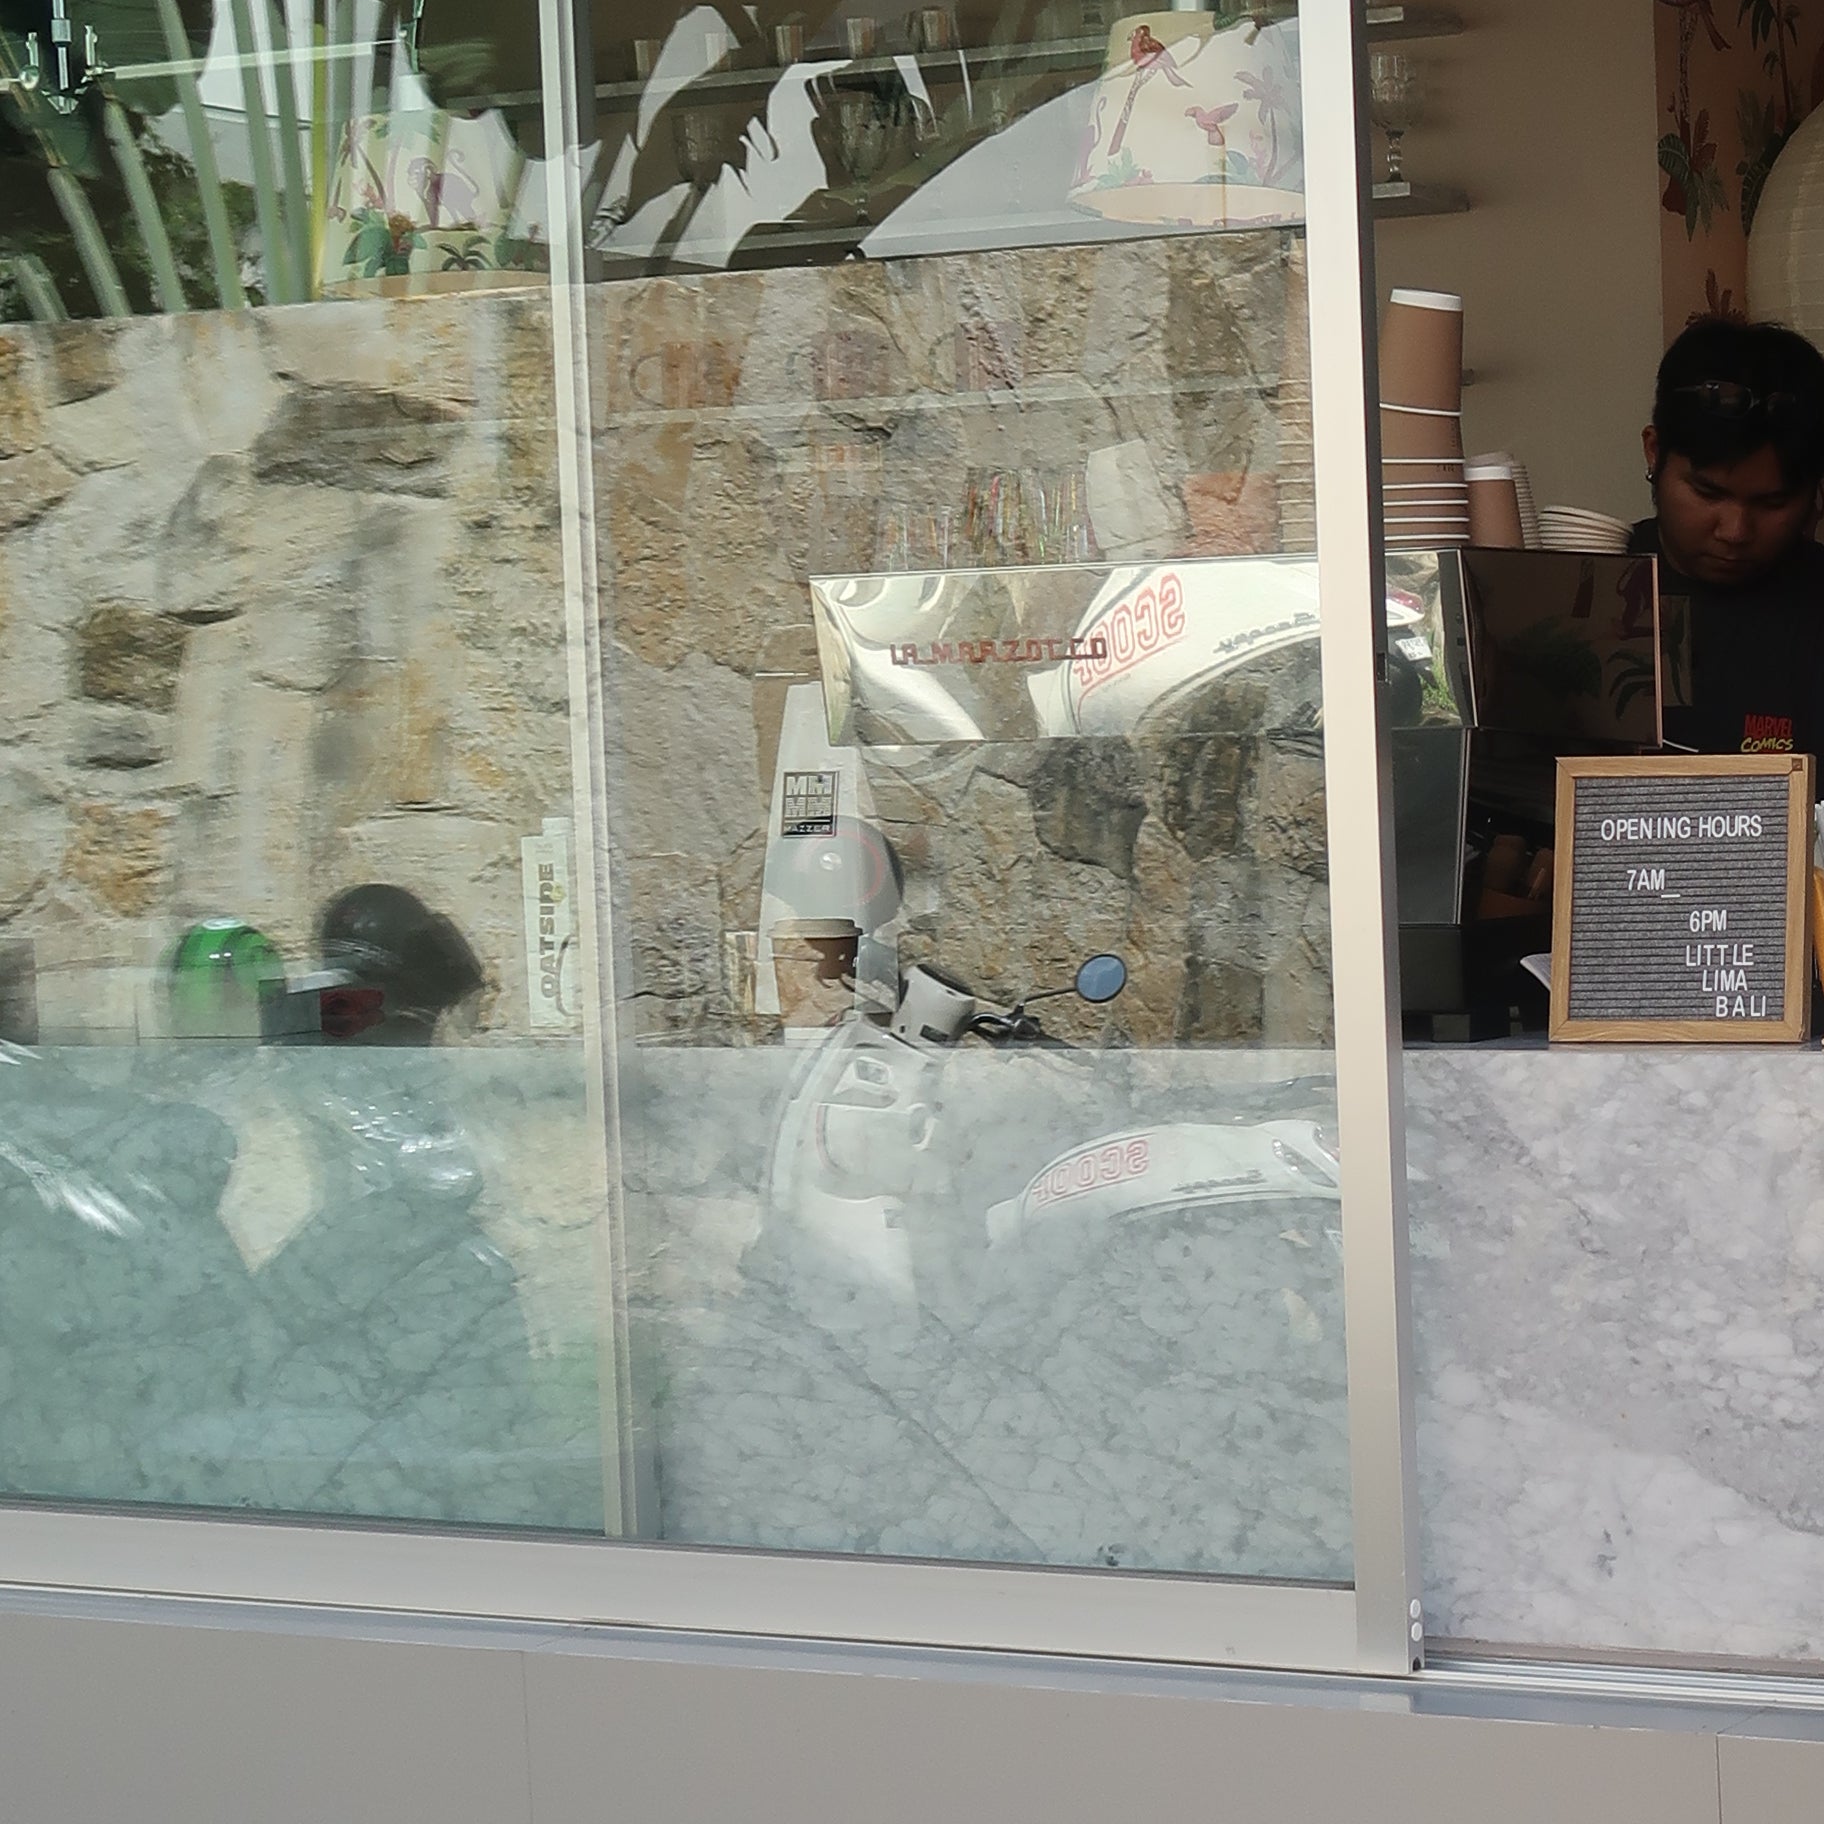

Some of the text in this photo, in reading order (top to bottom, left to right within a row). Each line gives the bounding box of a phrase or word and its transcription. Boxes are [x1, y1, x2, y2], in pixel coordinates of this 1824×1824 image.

[1744, 714, 1793, 738] MARVEL
[1600, 814, 1763, 841] OPENING HOURS
[1626, 868, 1666, 891] 7AM
[538, 862, 559, 999] OATSIDE
[1689, 909, 1727, 933] 6PM
[1686, 944, 1754, 967] LITTLE
[1702, 969, 1748, 992] LIMA
[1715, 995, 1767, 1018] BALI
